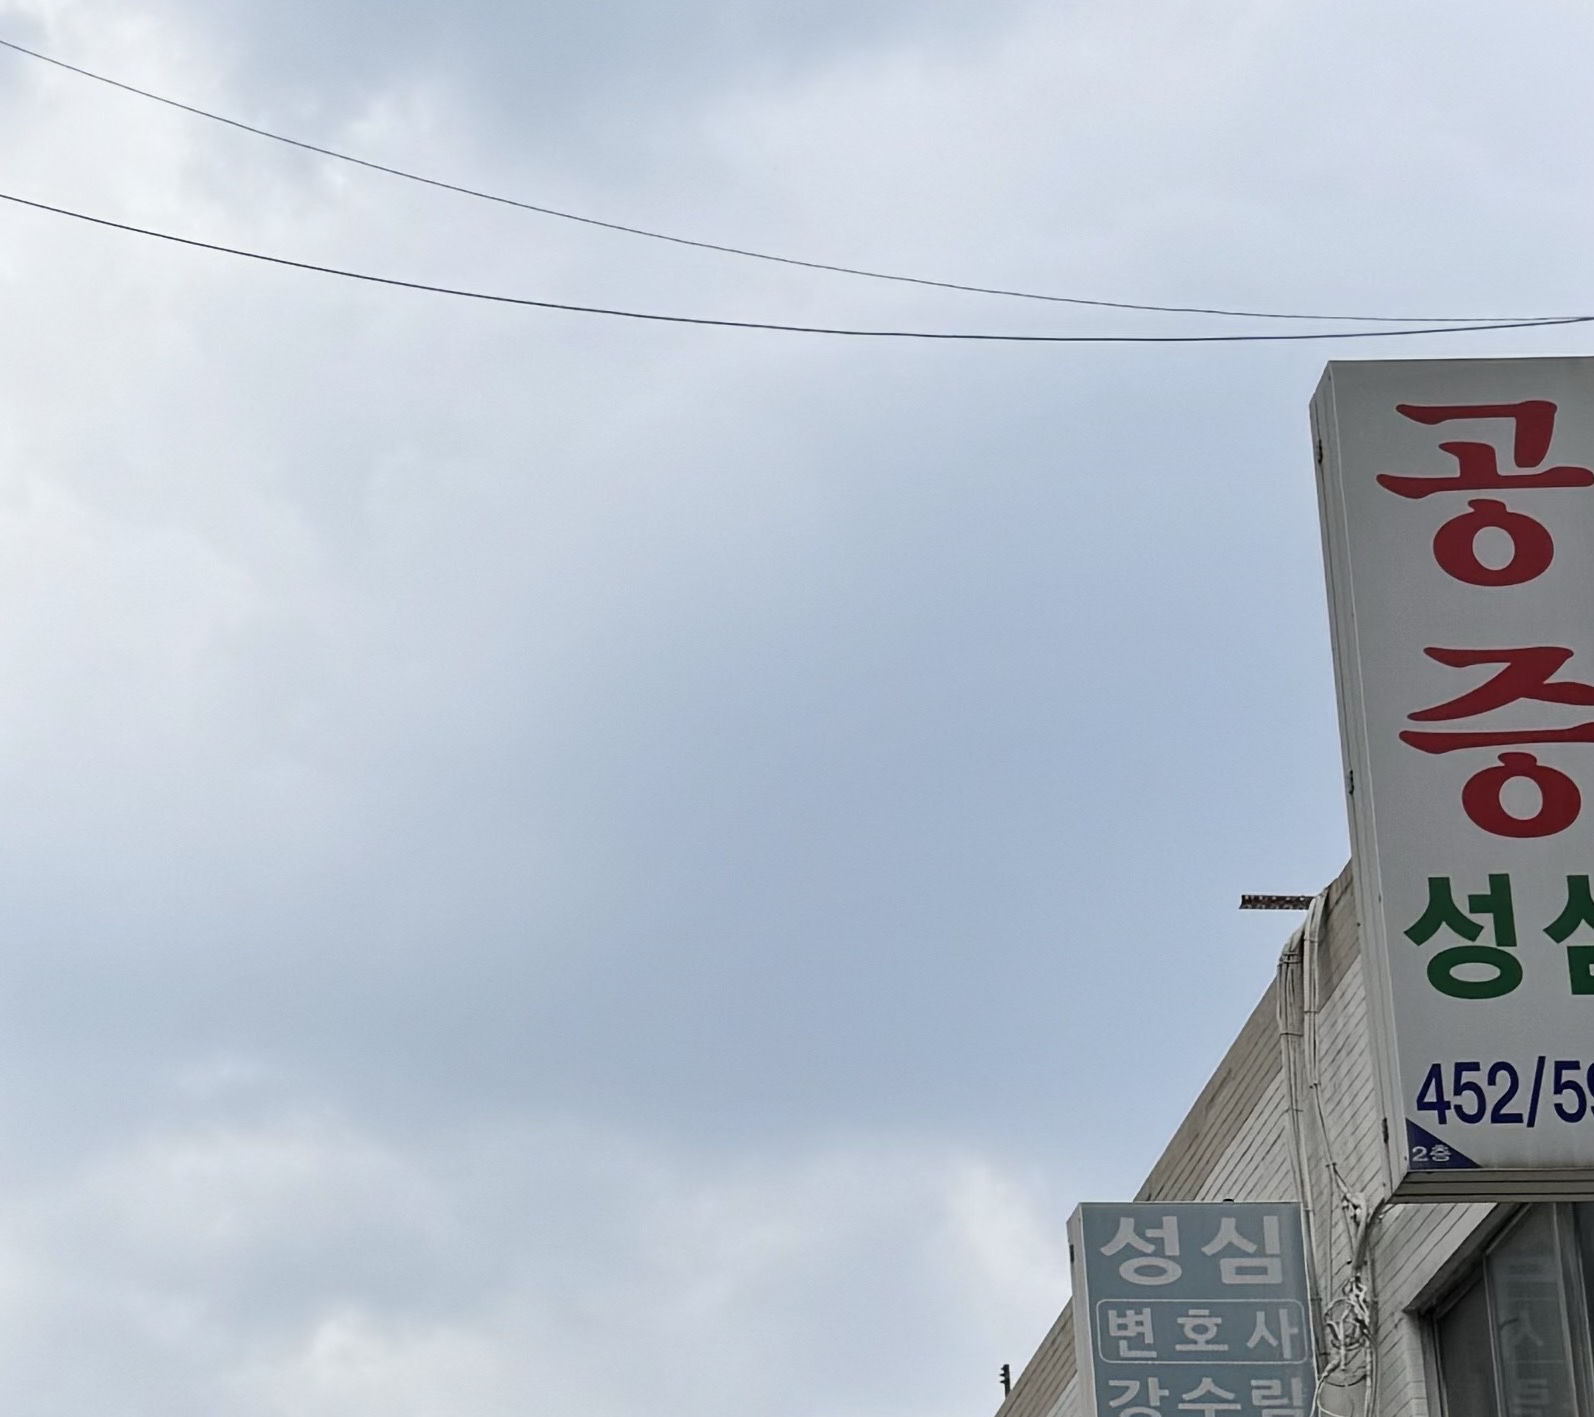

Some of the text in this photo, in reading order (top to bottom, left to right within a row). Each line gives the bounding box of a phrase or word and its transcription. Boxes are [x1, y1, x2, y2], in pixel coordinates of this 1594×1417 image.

[1376, 399, 1594, 840] 공증
[1410, 1142, 1451, 1165] 2층
[1100, 1215, 1283, 1286] 성심
[1108, 1306, 1299, 1358] 변호사
